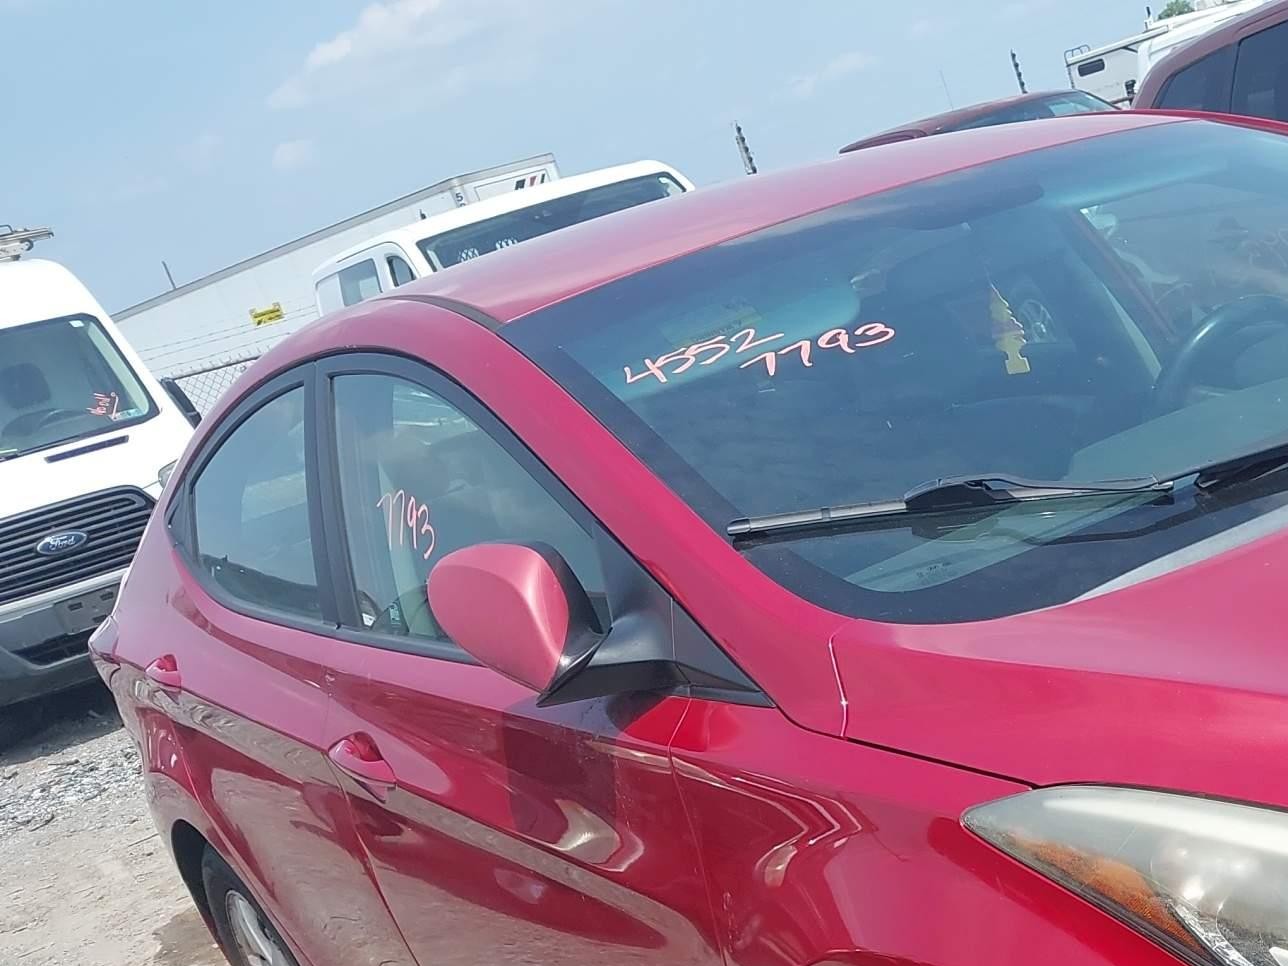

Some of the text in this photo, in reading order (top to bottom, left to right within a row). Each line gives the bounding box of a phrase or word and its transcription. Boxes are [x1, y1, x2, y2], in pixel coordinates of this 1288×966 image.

[623, 328, 784, 384] 4552
[738, 322, 895, 376] 7793
[48, 535, 76, 551] Ford
[376, 488, 435, 560] 7793
